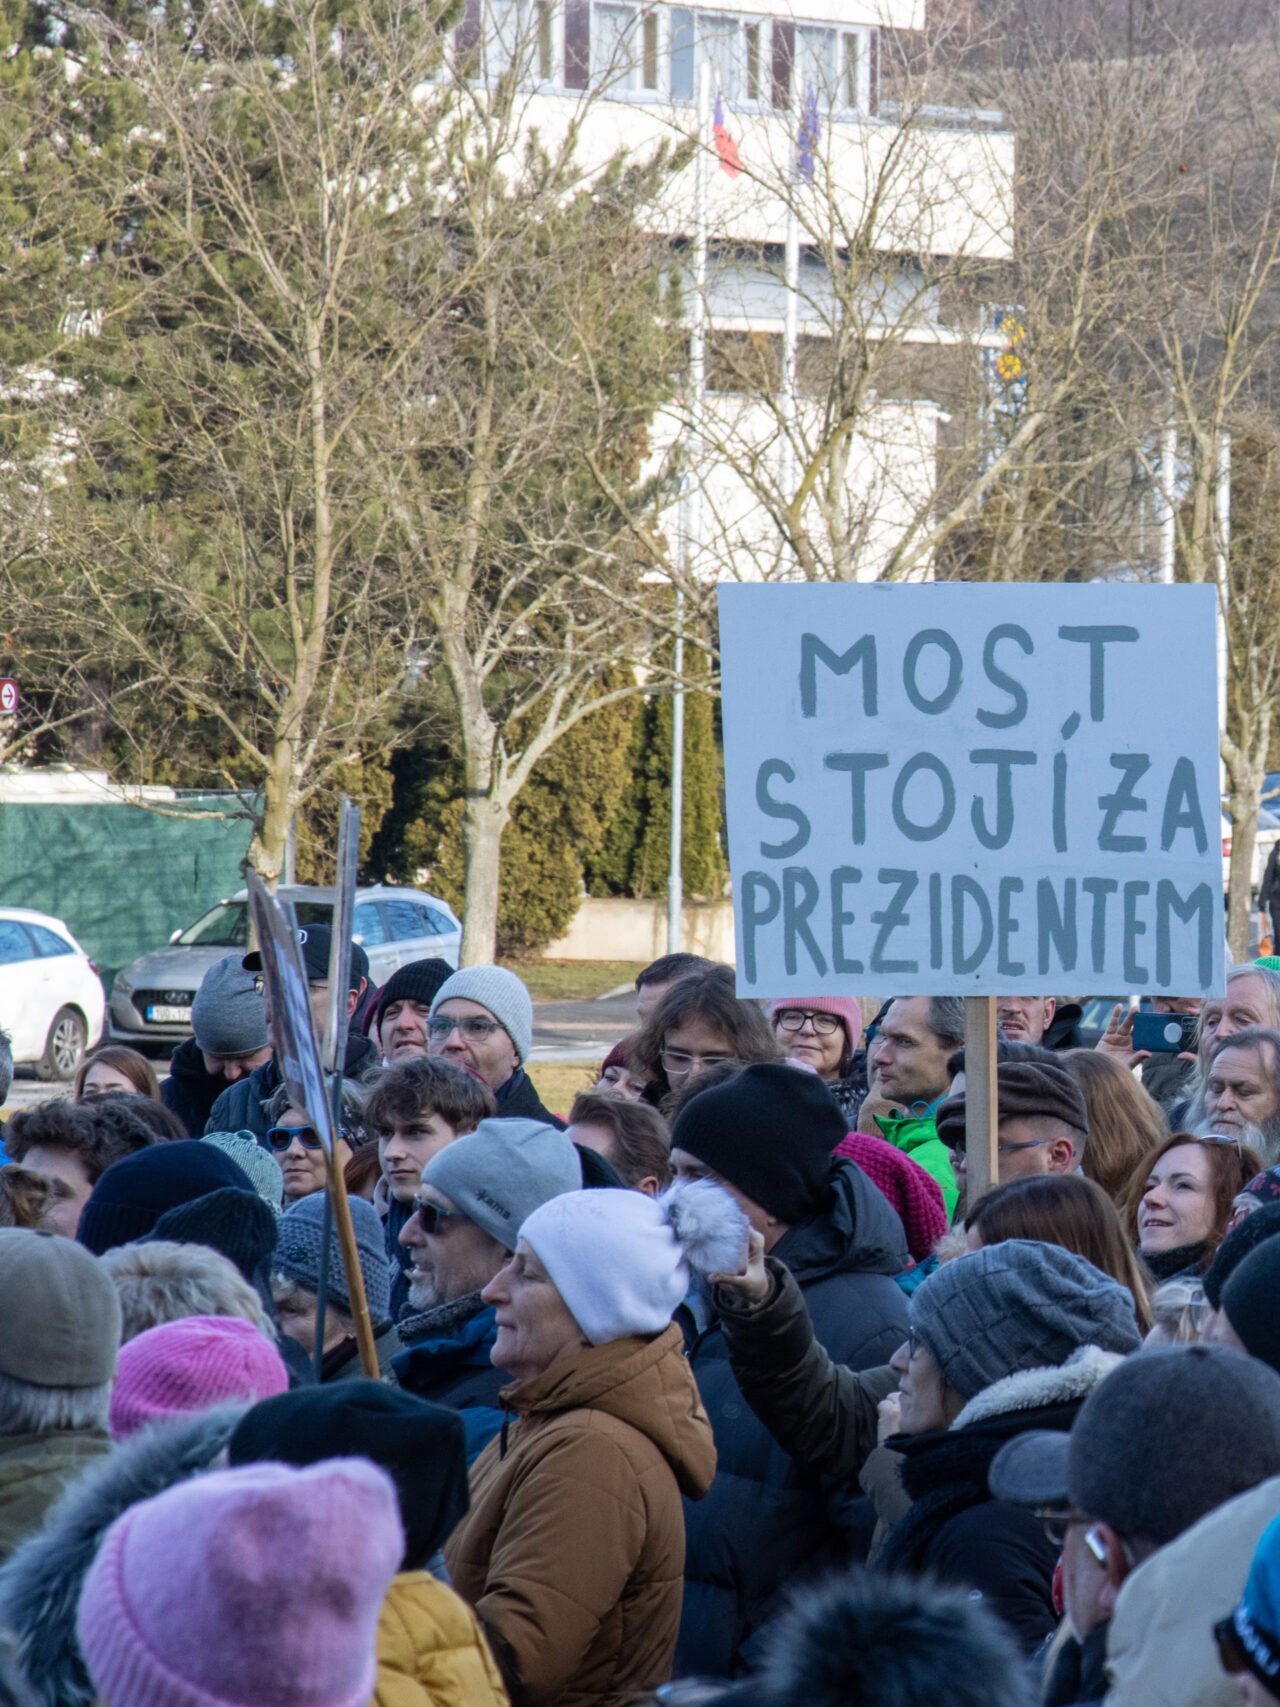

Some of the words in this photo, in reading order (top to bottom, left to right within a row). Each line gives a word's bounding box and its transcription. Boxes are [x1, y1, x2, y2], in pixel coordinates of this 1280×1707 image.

[799, 623, 1140, 729] MOST
[755, 711, 1083, 859] STOJÍ
[1097, 753, 1209, 855] ZA
[741, 866, 1214, 990] PREZIDENTEM
